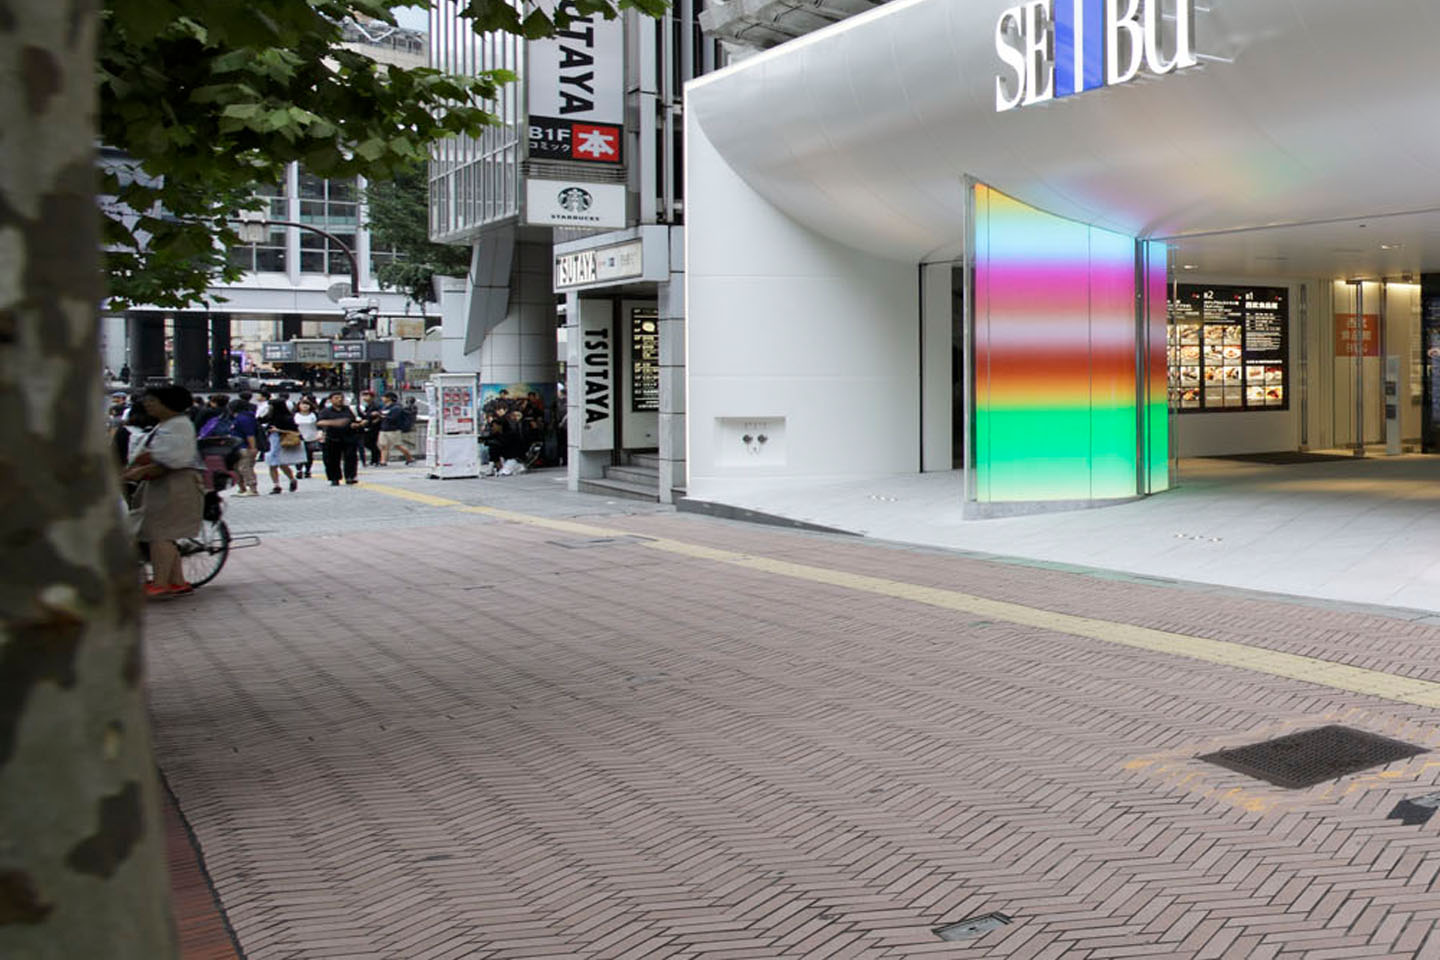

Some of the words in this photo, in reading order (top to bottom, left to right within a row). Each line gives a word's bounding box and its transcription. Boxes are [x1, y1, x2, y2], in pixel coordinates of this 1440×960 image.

[529, 126, 571, 141] B1F
[529, 141, 571, 153] コミック
[577, 130, 615, 158] 本
[551, 213, 600, 222] STARBUCKS
[584, 328, 609, 424] TSUTAYA
